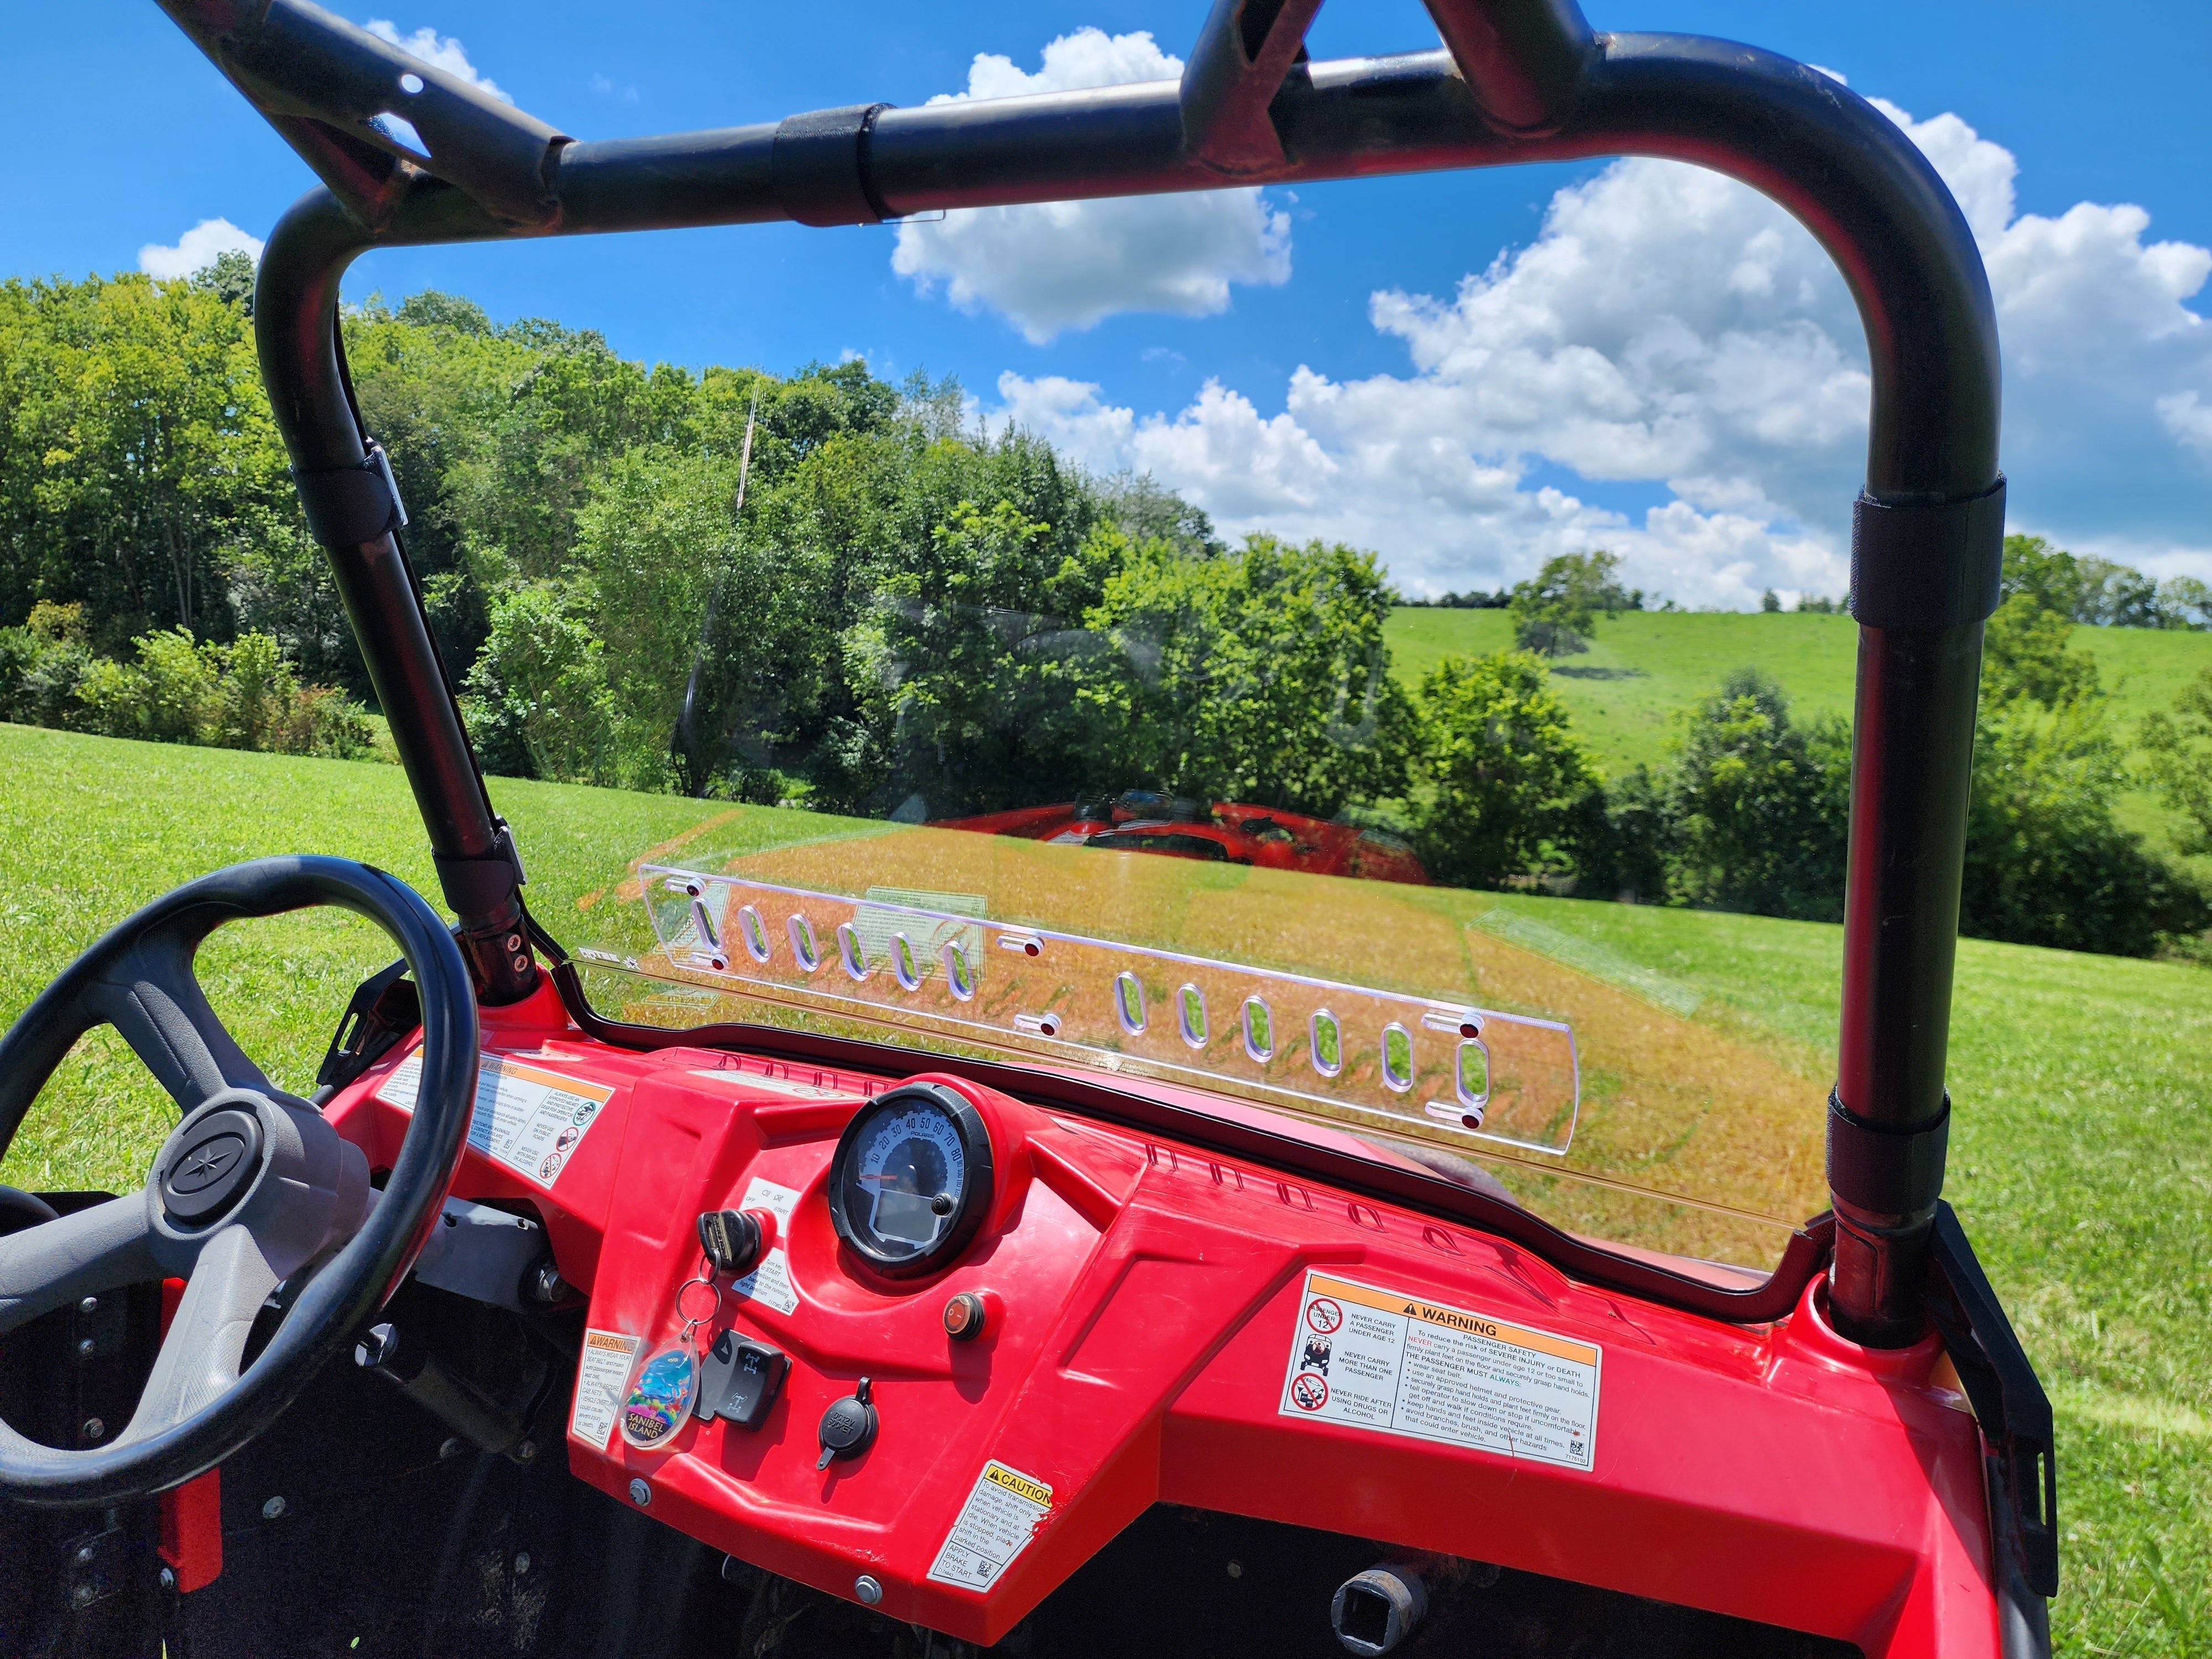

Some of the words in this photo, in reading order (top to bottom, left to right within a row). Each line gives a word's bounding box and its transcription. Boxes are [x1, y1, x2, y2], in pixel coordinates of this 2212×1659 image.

[489, 1062, 518, 1074] WARNING
[906, 1118, 916, 1130] 40
[920, 1117, 931, 1129] 50
[933, 1121, 945, 1135] 60
[891, 1124, 902, 1138] 30
[879, 1136, 890, 1150] 20
[944, 1132, 956, 1146] 70
[871, 1153, 880, 1164] 10
[951, 1147, 962, 1161] 80
[774, 1206, 789, 1215] START
[766, 1258, 775, 1266] Turn
[755, 1271, 771, 1281] position
[765, 1267, 781, 1276] START
[739, 1280, 750, 1288] light
[748, 1285, 767, 1296] position
[771, 1287, 789, 1298] running
[1308, 1305, 1342, 1317] PASSENGER
[1313, 1312, 1335, 1322] UNDER
[1318, 1320, 1328, 1329] 12
[1351, 1313, 1372, 1323] NEVER
[1374, 1319, 1396, 1328] CARRY
[1423, 1307, 1496, 1335] WARNING
[1349, 1327, 1371, 1337] UNDER
[1355, 1322, 1394, 1335] PASSENGER
[595, 1337, 634, 1351] WARNING
[1463, 1334, 1506, 1350] PASSENGER
[1508, 1346, 1536, 1358] SAFETY
[1344, 1350, 1365, 1360] NEVER
[1367, 1357, 1390, 1366] CARRY
[1408, 1335, 1432, 1346] NEVER
[1433, 1343, 1449, 1352] carry
[1457, 1349, 1491, 1361] passenger
[1493, 1359, 1511, 1367] under
[1557, 1376, 1574, 1385] small
[1427, 1333, 1451, 1343] reduce
[1488, 1348, 1516, 1360] SEVERE
[1519, 1357, 1545, 1368] INJURY
[1556, 1366, 1580, 1378] DEATH
[1338, 1357, 1358, 1366] MORE
[1360, 1362, 1377, 1371] THAN
[1379, 1367, 1392, 1375] ONE
[1345, 1366, 1383, 1380] PASSENGER
[1405, 1351, 1420, 1360] THE
[1421, 1355, 1464, 1371] PASSENGER
[1467, 1368, 1487, 1378] MUST
[1489, 1374, 1521, 1387] ALWAYS:
[1406, 1343, 1423, 1353] firmly
[1425, 1349, 1440, 1357] plant
[1442, 1352, 1454, 1360] feet
[1477, 1361, 1491, 1370] floor
[1506, 1371, 1532, 1383] securely
[1533, 1378, 1552, 1387] grasp
[1553, 1383, 1569, 1392] hand
[1571, 1387, 1589, 1397] holds.
[1447, 1370, 1461, 1379] belt.
[586, 1380, 603, 1389] ALWAYS
[1331, 1387, 1352, 1397] NEVER
[1353, 1394, 1369, 1402] RIDE
[1370, 1398, 1391, 1408] AFTER
[1436, 1376, 1468, 1388] approved
[1469, 1384, 1492, 1395] helmet
[1509, 1396, 1542, 1408] protective
[1545, 1406, 1561, 1414] gear.
[1332, 1395, 1352, 1405] USING
[1353, 1401, 1376, 1412] DRUGS
[1343, 1407, 1374, 1420] ALCOHOL
[628, 1413, 663, 1432] SANIBEL
[628, 1422, 658, 1438] ISLAND
[828, 1418, 853, 1435] SOCKET
[1566, 1453, 1585, 1464] 7175102
[1001, 1474, 1051, 1504] CAUTION
[975, 1496, 990, 1507] when
[992, 1504, 1012, 1517] vehicle
[979, 1489, 1003, 1505] damage,
[1005, 1501, 1018, 1510] shift
[1019, 1508, 1032, 1517] only
[990, 1486, 1007, 1496] avoid
[1008, 1493, 1045, 1513] transmission
[971, 1504, 999, 1521] stationary
[1000, 1518, 1013, 1527] and
[967, 1512, 978, 1521] idle.
[980, 1517, 997, 1529] When
[999, 1526, 1019, 1540] vehicle
[969, 1522, 994, 1538] stopped,
[958, 1527, 972, 1536] shift
[979, 1536, 989, 1545] the
[948, 1545, 970, 1557] APPLY
[954, 1535, 975, 1548] parked
[975, 1545, 1000, 1561] position.
[945, 1552, 967, 1567] BRAKE
[942, 1559, 950, 1568] TO
[951, 1564, 972, 1578] START
